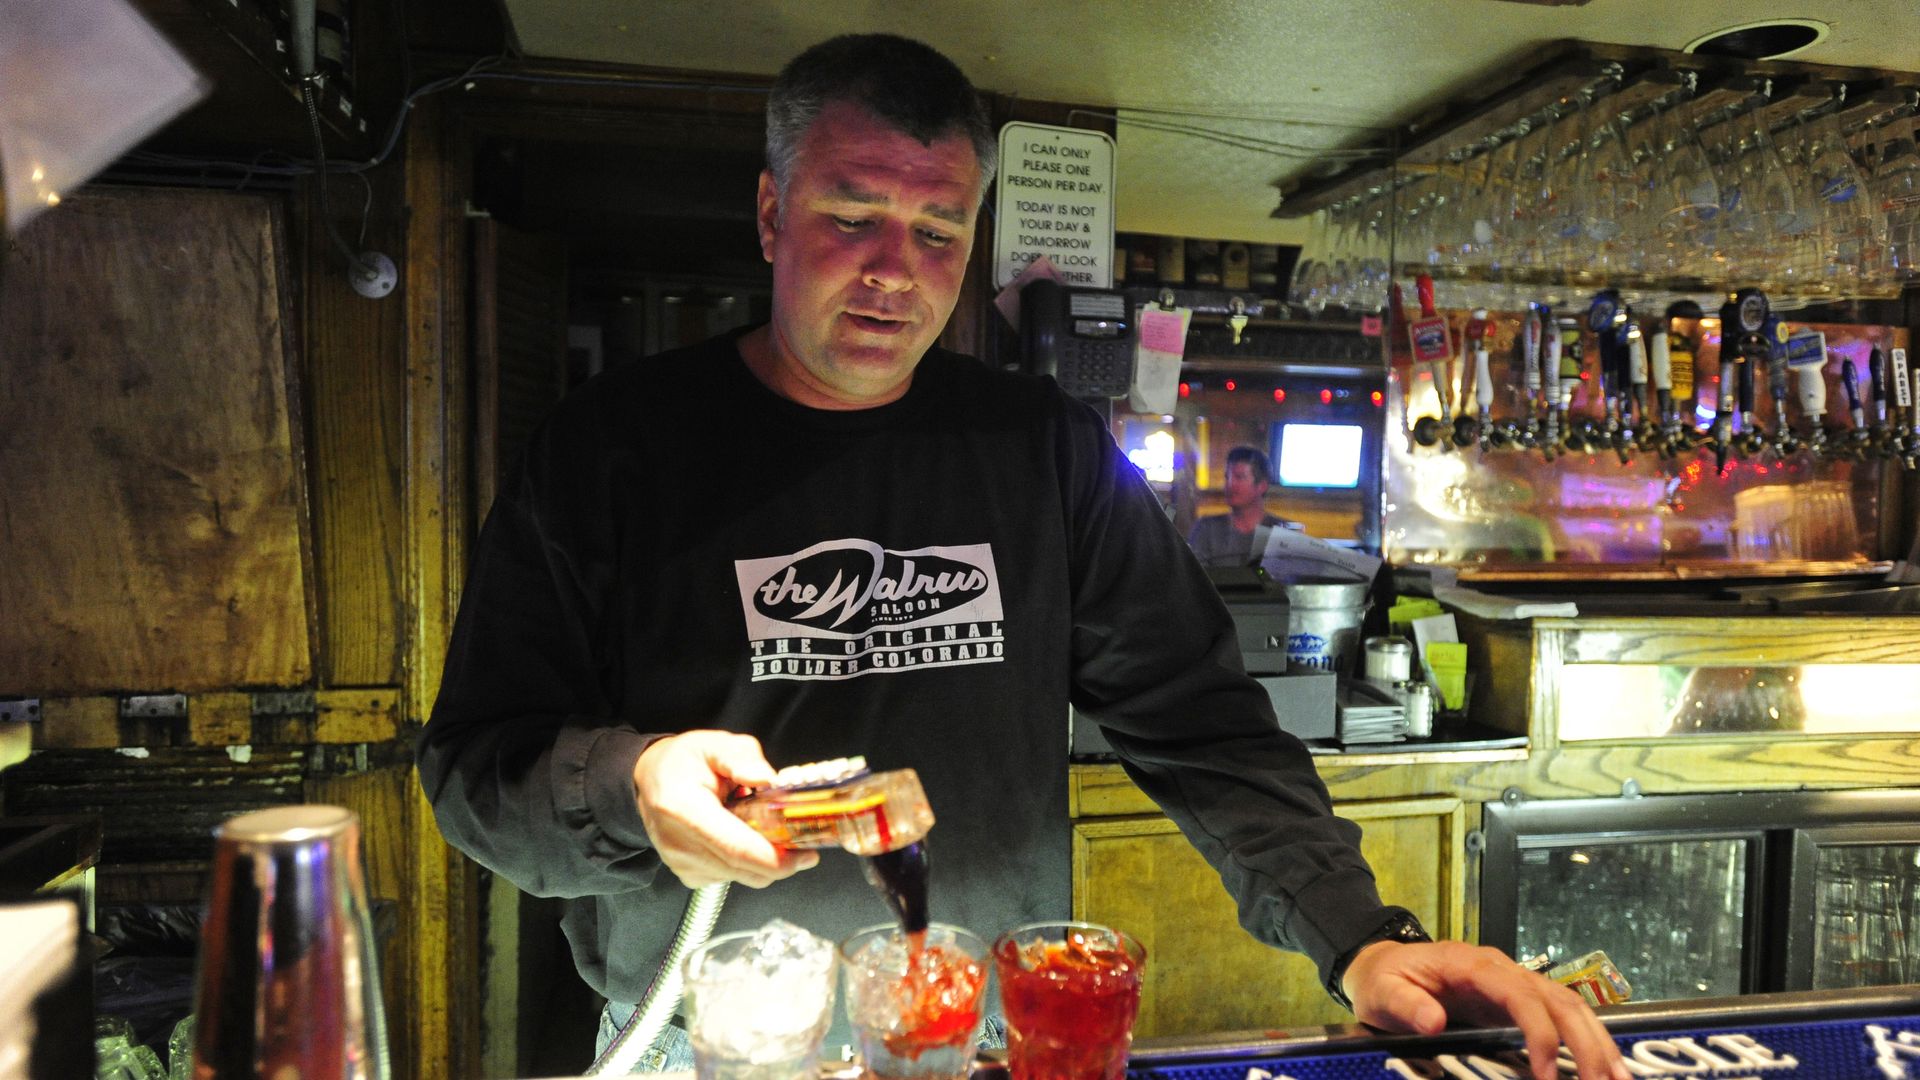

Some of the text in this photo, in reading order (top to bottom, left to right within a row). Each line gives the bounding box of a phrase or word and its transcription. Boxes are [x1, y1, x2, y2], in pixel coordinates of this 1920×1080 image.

[1030, 143, 1057, 156] CAN
[1060, 146, 1091, 160] ONLY
[1023, 159, 1091, 176] PLEASE ONE
[1007, 175, 1052, 189] PERSON
[1055, 181, 1075, 193] PER
[1016, 200, 1097, 217] TODAY IS NOT
[1019, 217, 1091, 233] YOUR DAY &
[1018, 234, 1092, 249] TOMORROW
[1064, 255, 1097, 267] LOOK
[760, 542, 988, 629] the Walrus
[870, 598, 940, 617] SALOON
[751, 622, 1002, 656] THE ORIGINAL
[752, 642, 1004, 676] BOULDER COLORADO
